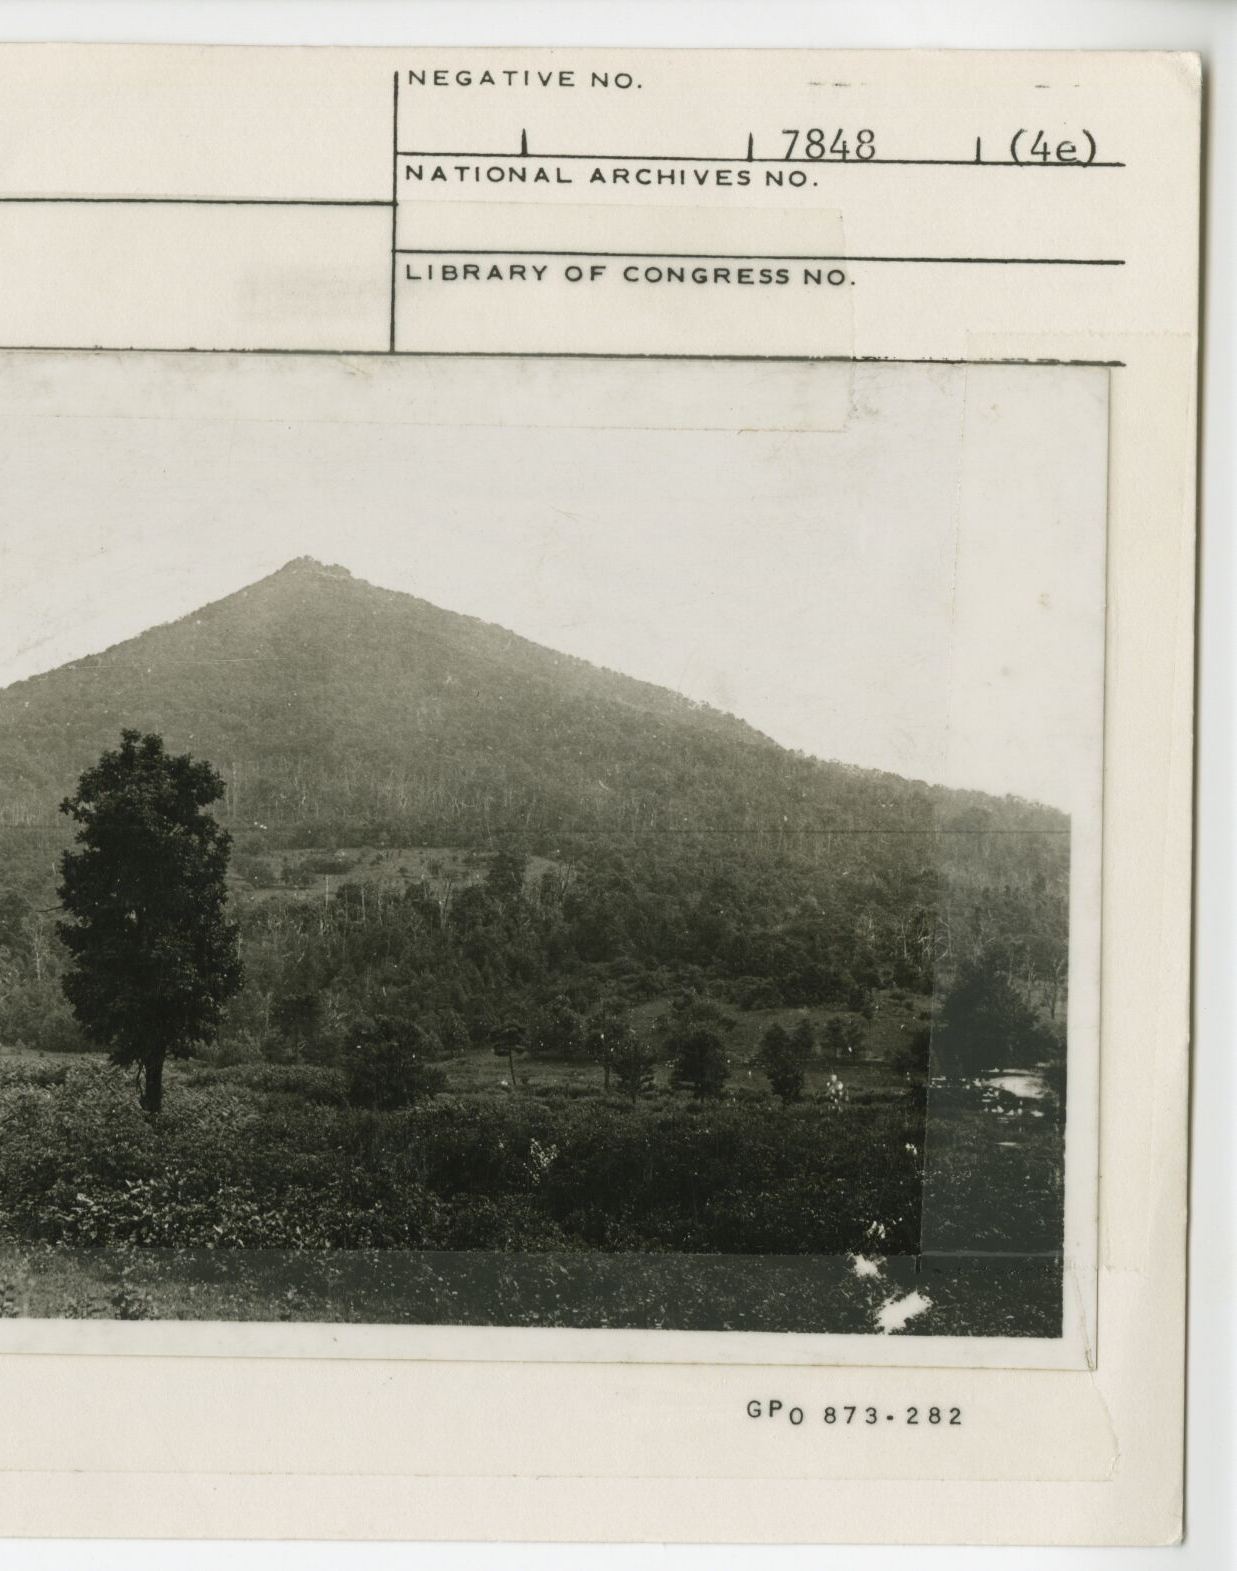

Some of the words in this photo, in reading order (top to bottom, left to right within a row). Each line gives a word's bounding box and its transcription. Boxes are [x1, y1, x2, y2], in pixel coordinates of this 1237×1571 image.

[408, 69, 576, 88] NEGATIVE
[590, 71, 643, 90] NO.
[781, 128, 876, 160] 7848
[1009, 128, 1097, 166] (4e)
[405, 164, 573, 185] NATIONAL
[590, 167, 752, 188] ARCHIVES
[765, 169, 819, 189] NO.
[405, 263, 548, 282] LIBRARY
[564, 264, 607, 283] OF
[622, 265, 791, 286] CONGRESS
[802, 268, 856, 287] NO.
[823, 1405, 962, 1426] 873-282
